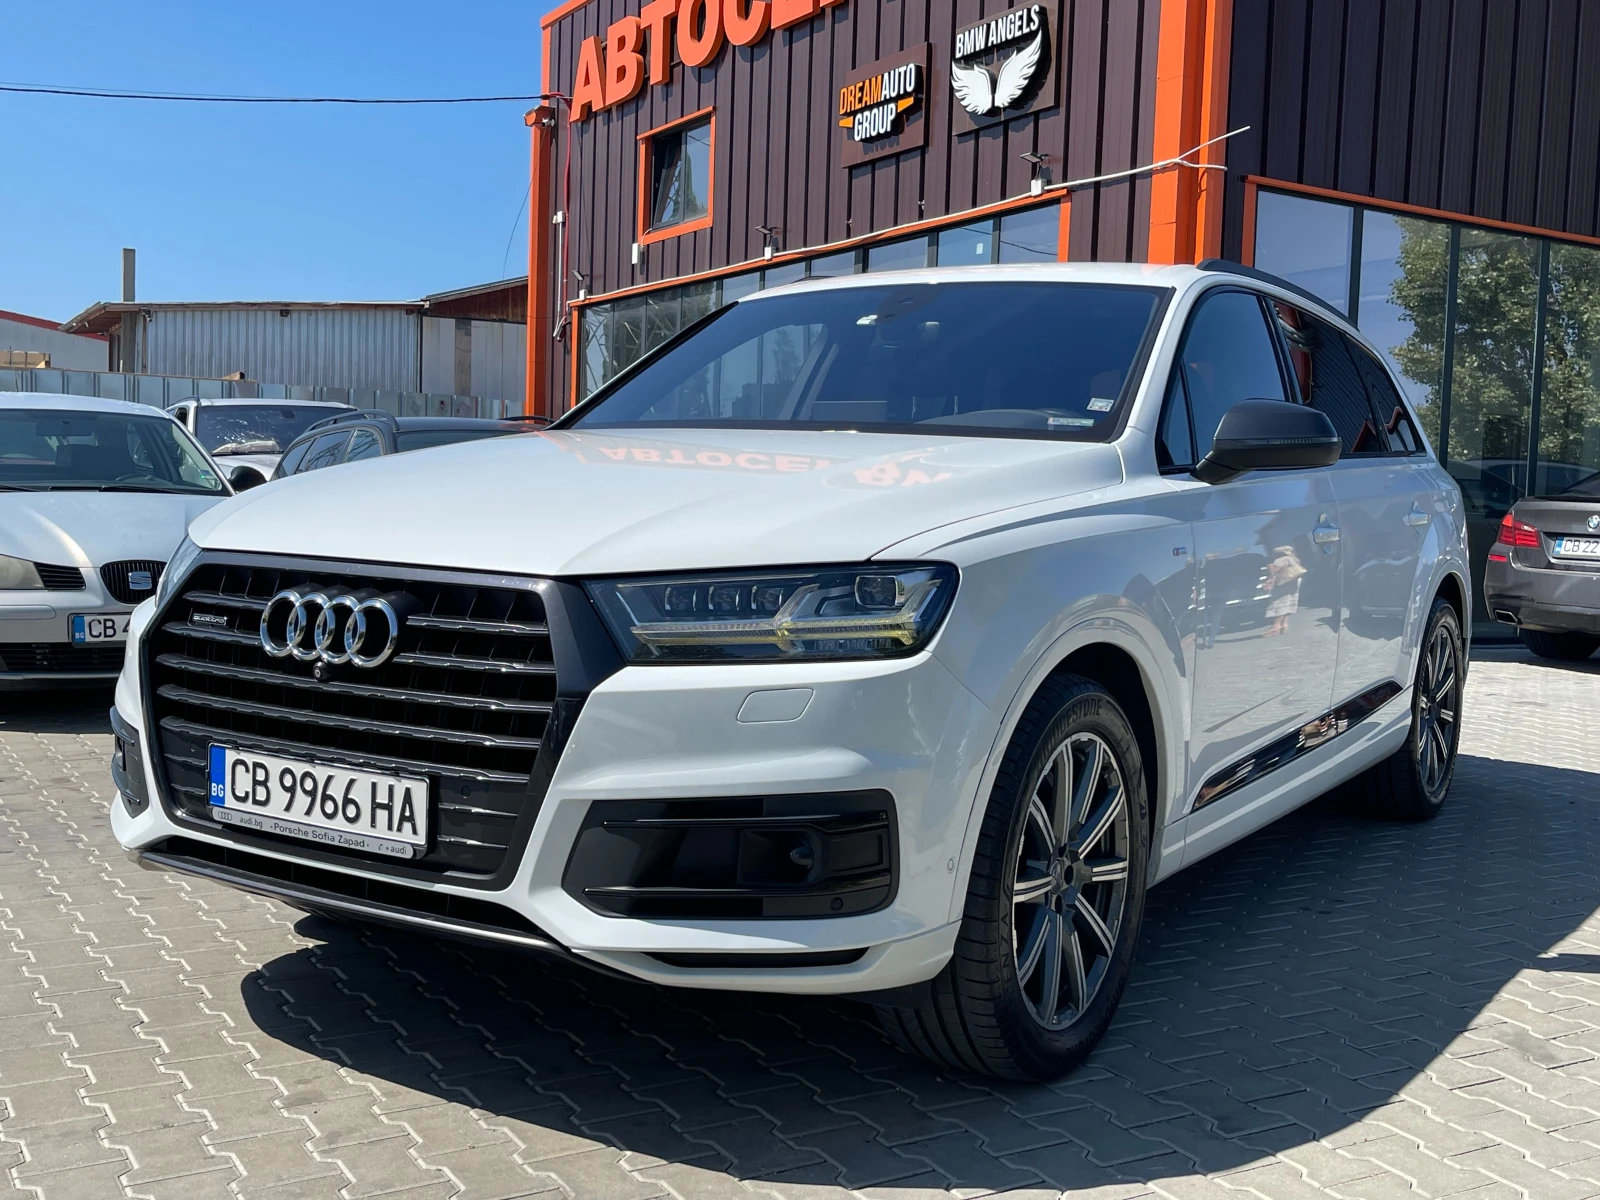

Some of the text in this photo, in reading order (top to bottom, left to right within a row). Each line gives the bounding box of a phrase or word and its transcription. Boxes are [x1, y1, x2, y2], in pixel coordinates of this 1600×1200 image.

[955, 4, 1040, 59] BMW ANGELS
[854, 103, 896, 142] GROUP
[1563, 539, 1581, 553] CB
[88, 618, 117, 638] CB
[211, 782, 224, 798] BG
[231, 758, 418, 836] CB 9966 HA
[239, 817, 263, 829] audi.bg
[311, 829, 335, 842] Sofia
[337, 834, 365, 848] Zapad
